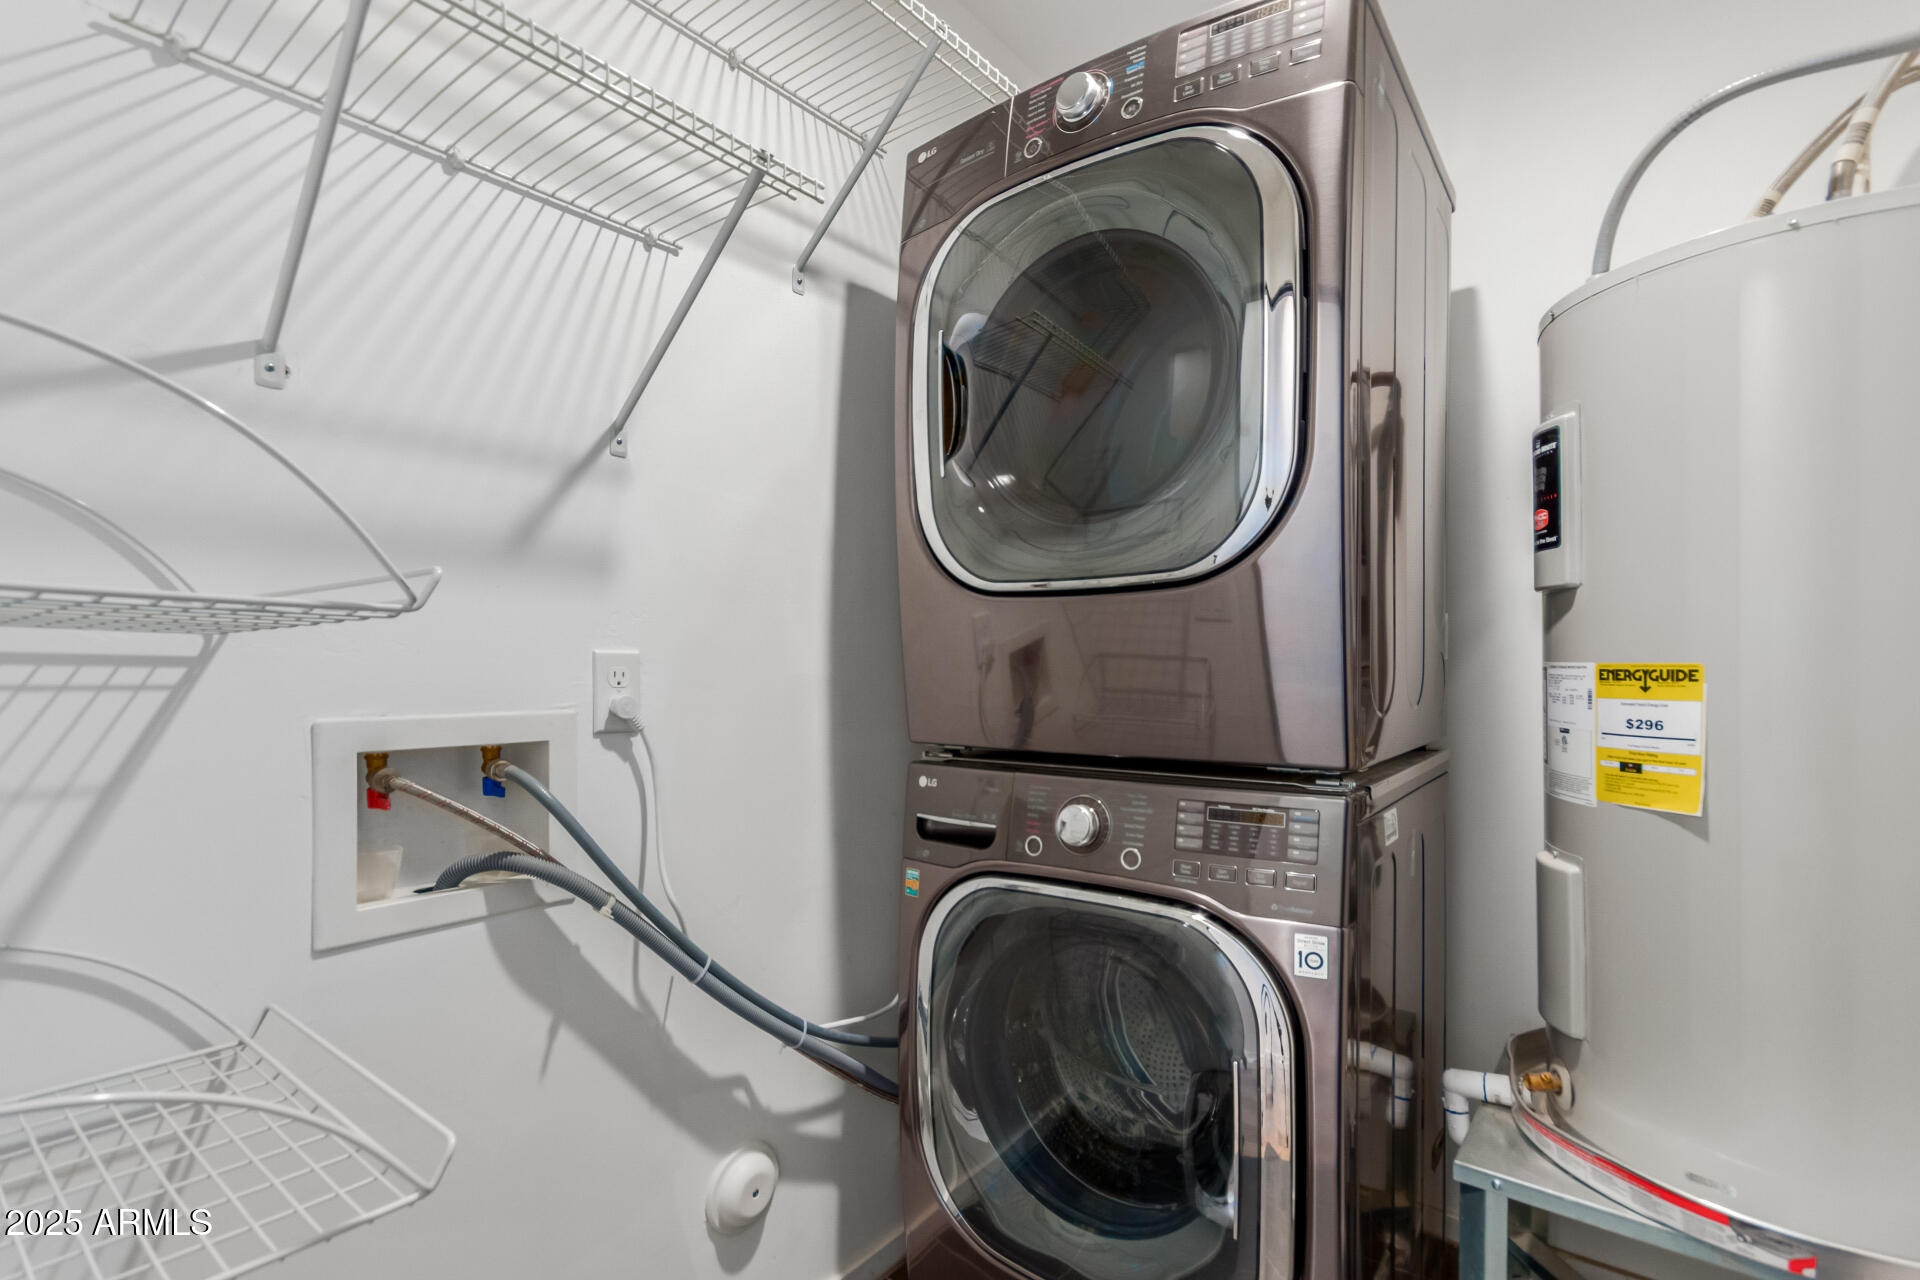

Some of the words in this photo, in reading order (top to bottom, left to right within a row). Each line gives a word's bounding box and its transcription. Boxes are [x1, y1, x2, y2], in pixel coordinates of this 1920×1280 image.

[1599, 668, 1700, 683] ENERGYGUIDE
[1625, 718, 1665, 732] $296
[1298, 950, 1324, 970] 10
